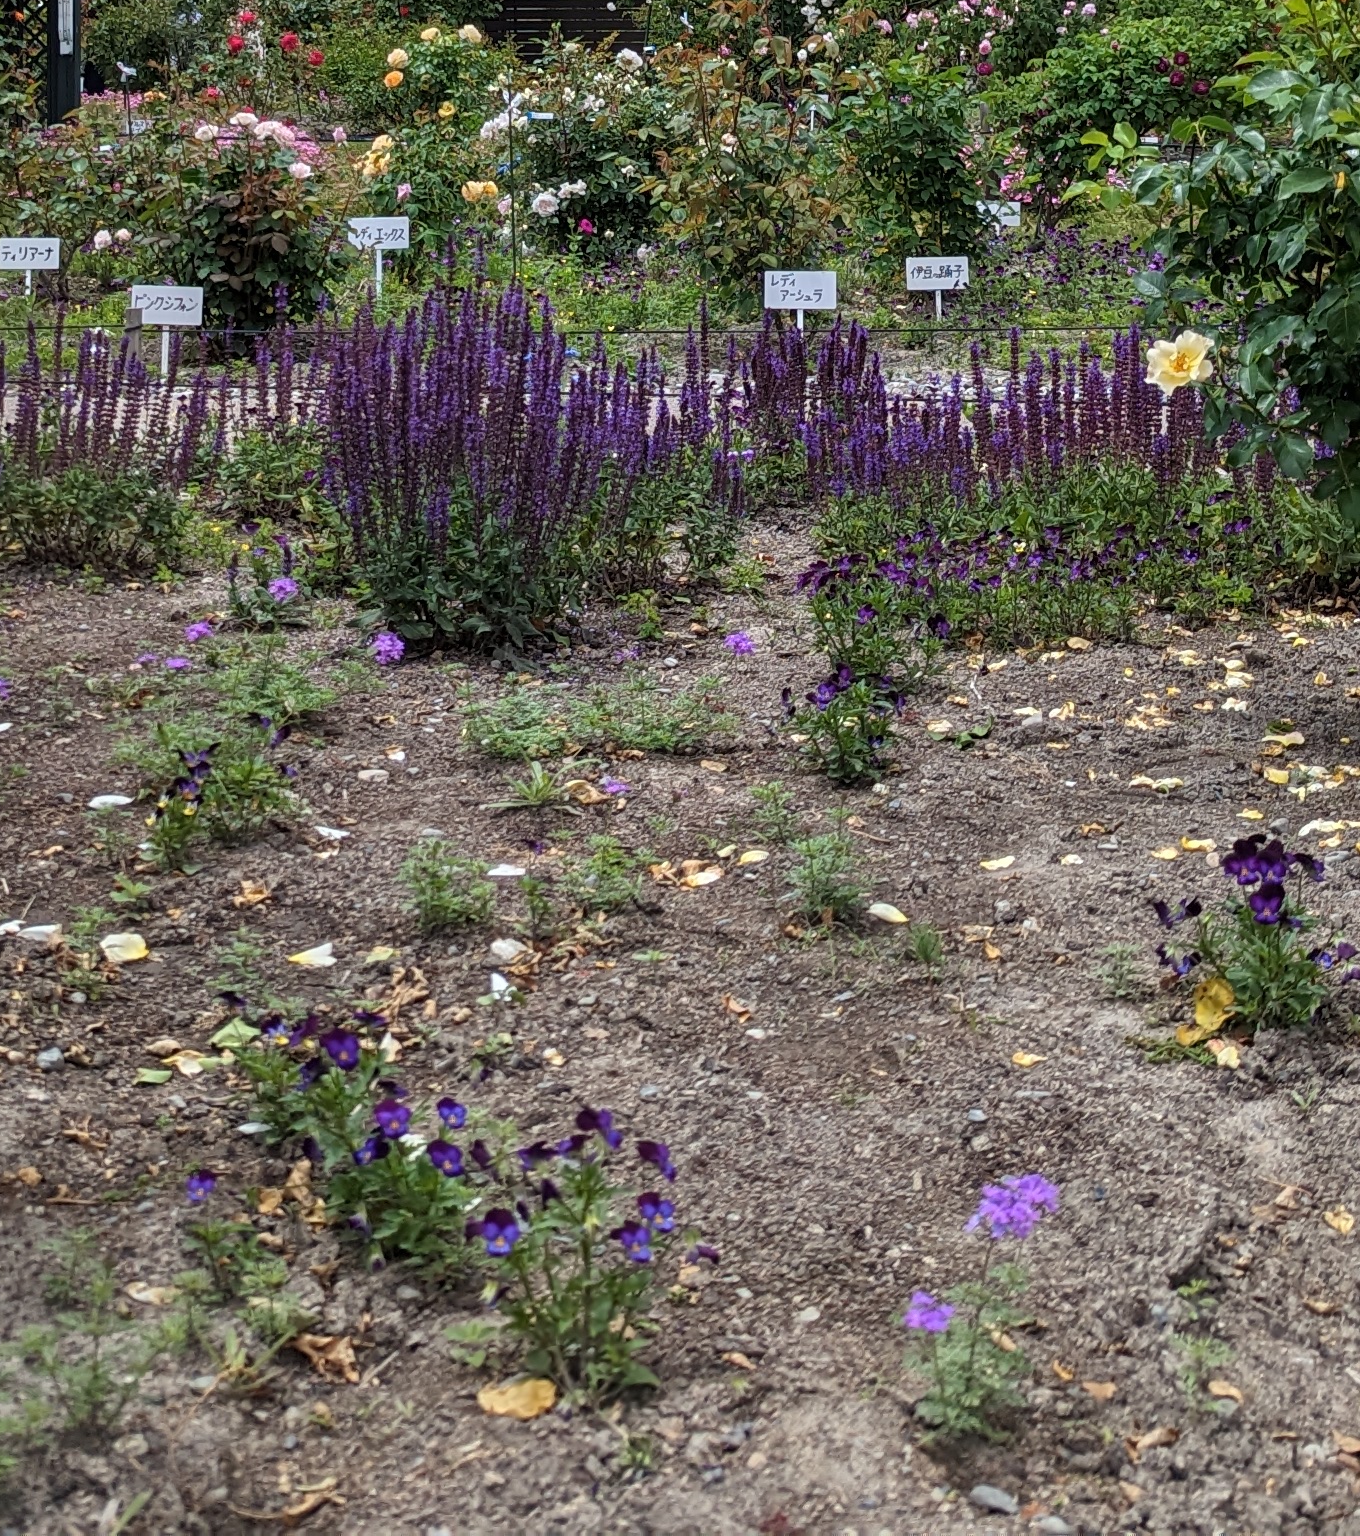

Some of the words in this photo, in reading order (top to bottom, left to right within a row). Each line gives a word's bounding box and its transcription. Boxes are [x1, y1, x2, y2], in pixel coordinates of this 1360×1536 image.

[1, 245, 55, 262] ティリアーナ
[770, 272, 797, 288] レディ
[910, 264, 965, 280] 伊豆の踊子
[134, 293, 199, 312] ピンクシフォン
[779, 288, 824, 304] アーシュラ
